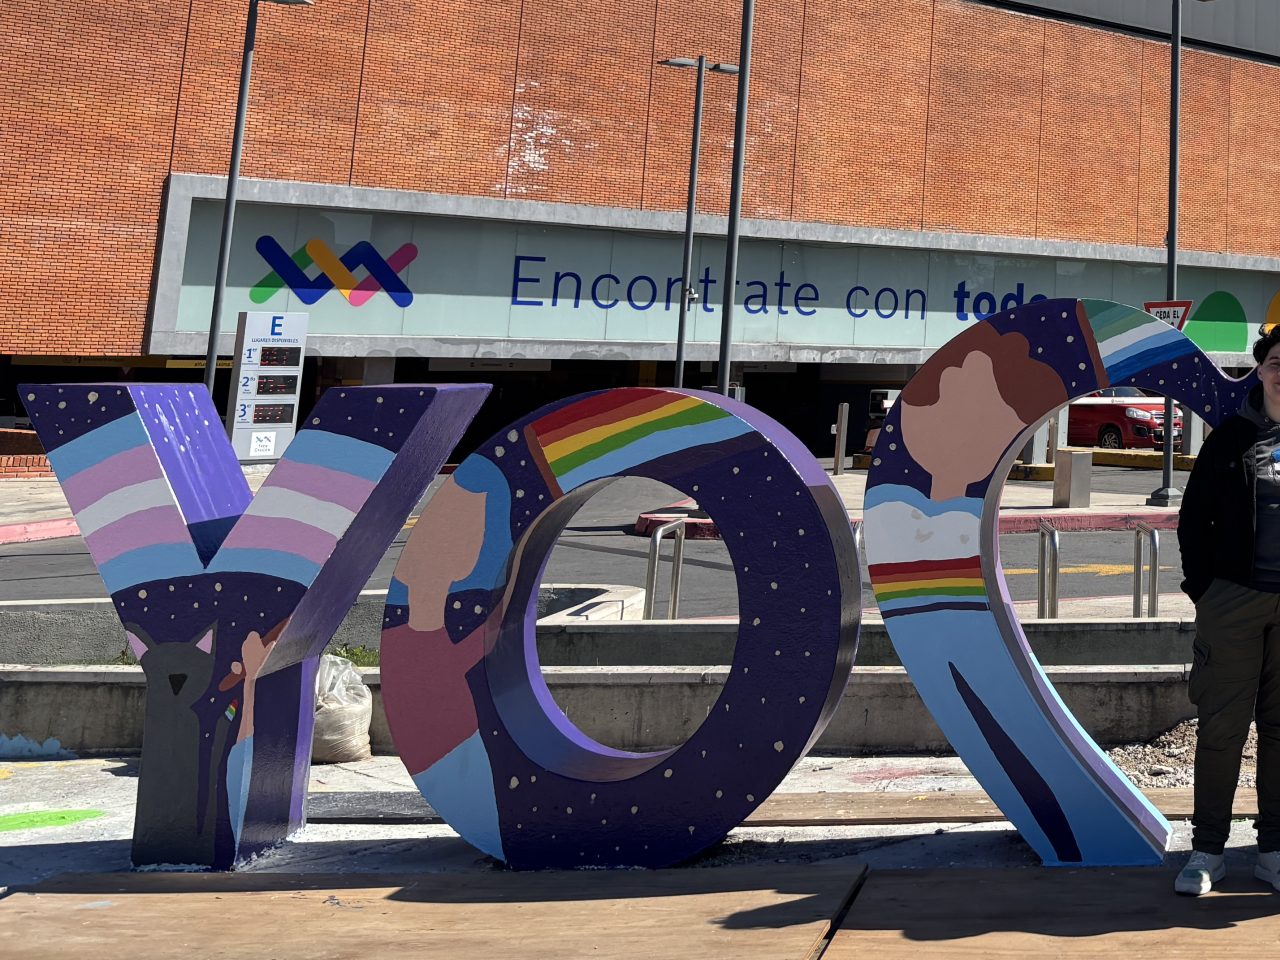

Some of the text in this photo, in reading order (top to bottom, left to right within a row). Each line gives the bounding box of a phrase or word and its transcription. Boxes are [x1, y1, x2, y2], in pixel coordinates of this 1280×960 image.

[511, 255, 820, 317] Encontate
[845, 285, 927, 321] con
[270, 315, 284, 336] E
[1155, 310, 1180, 320] CEDA EL
